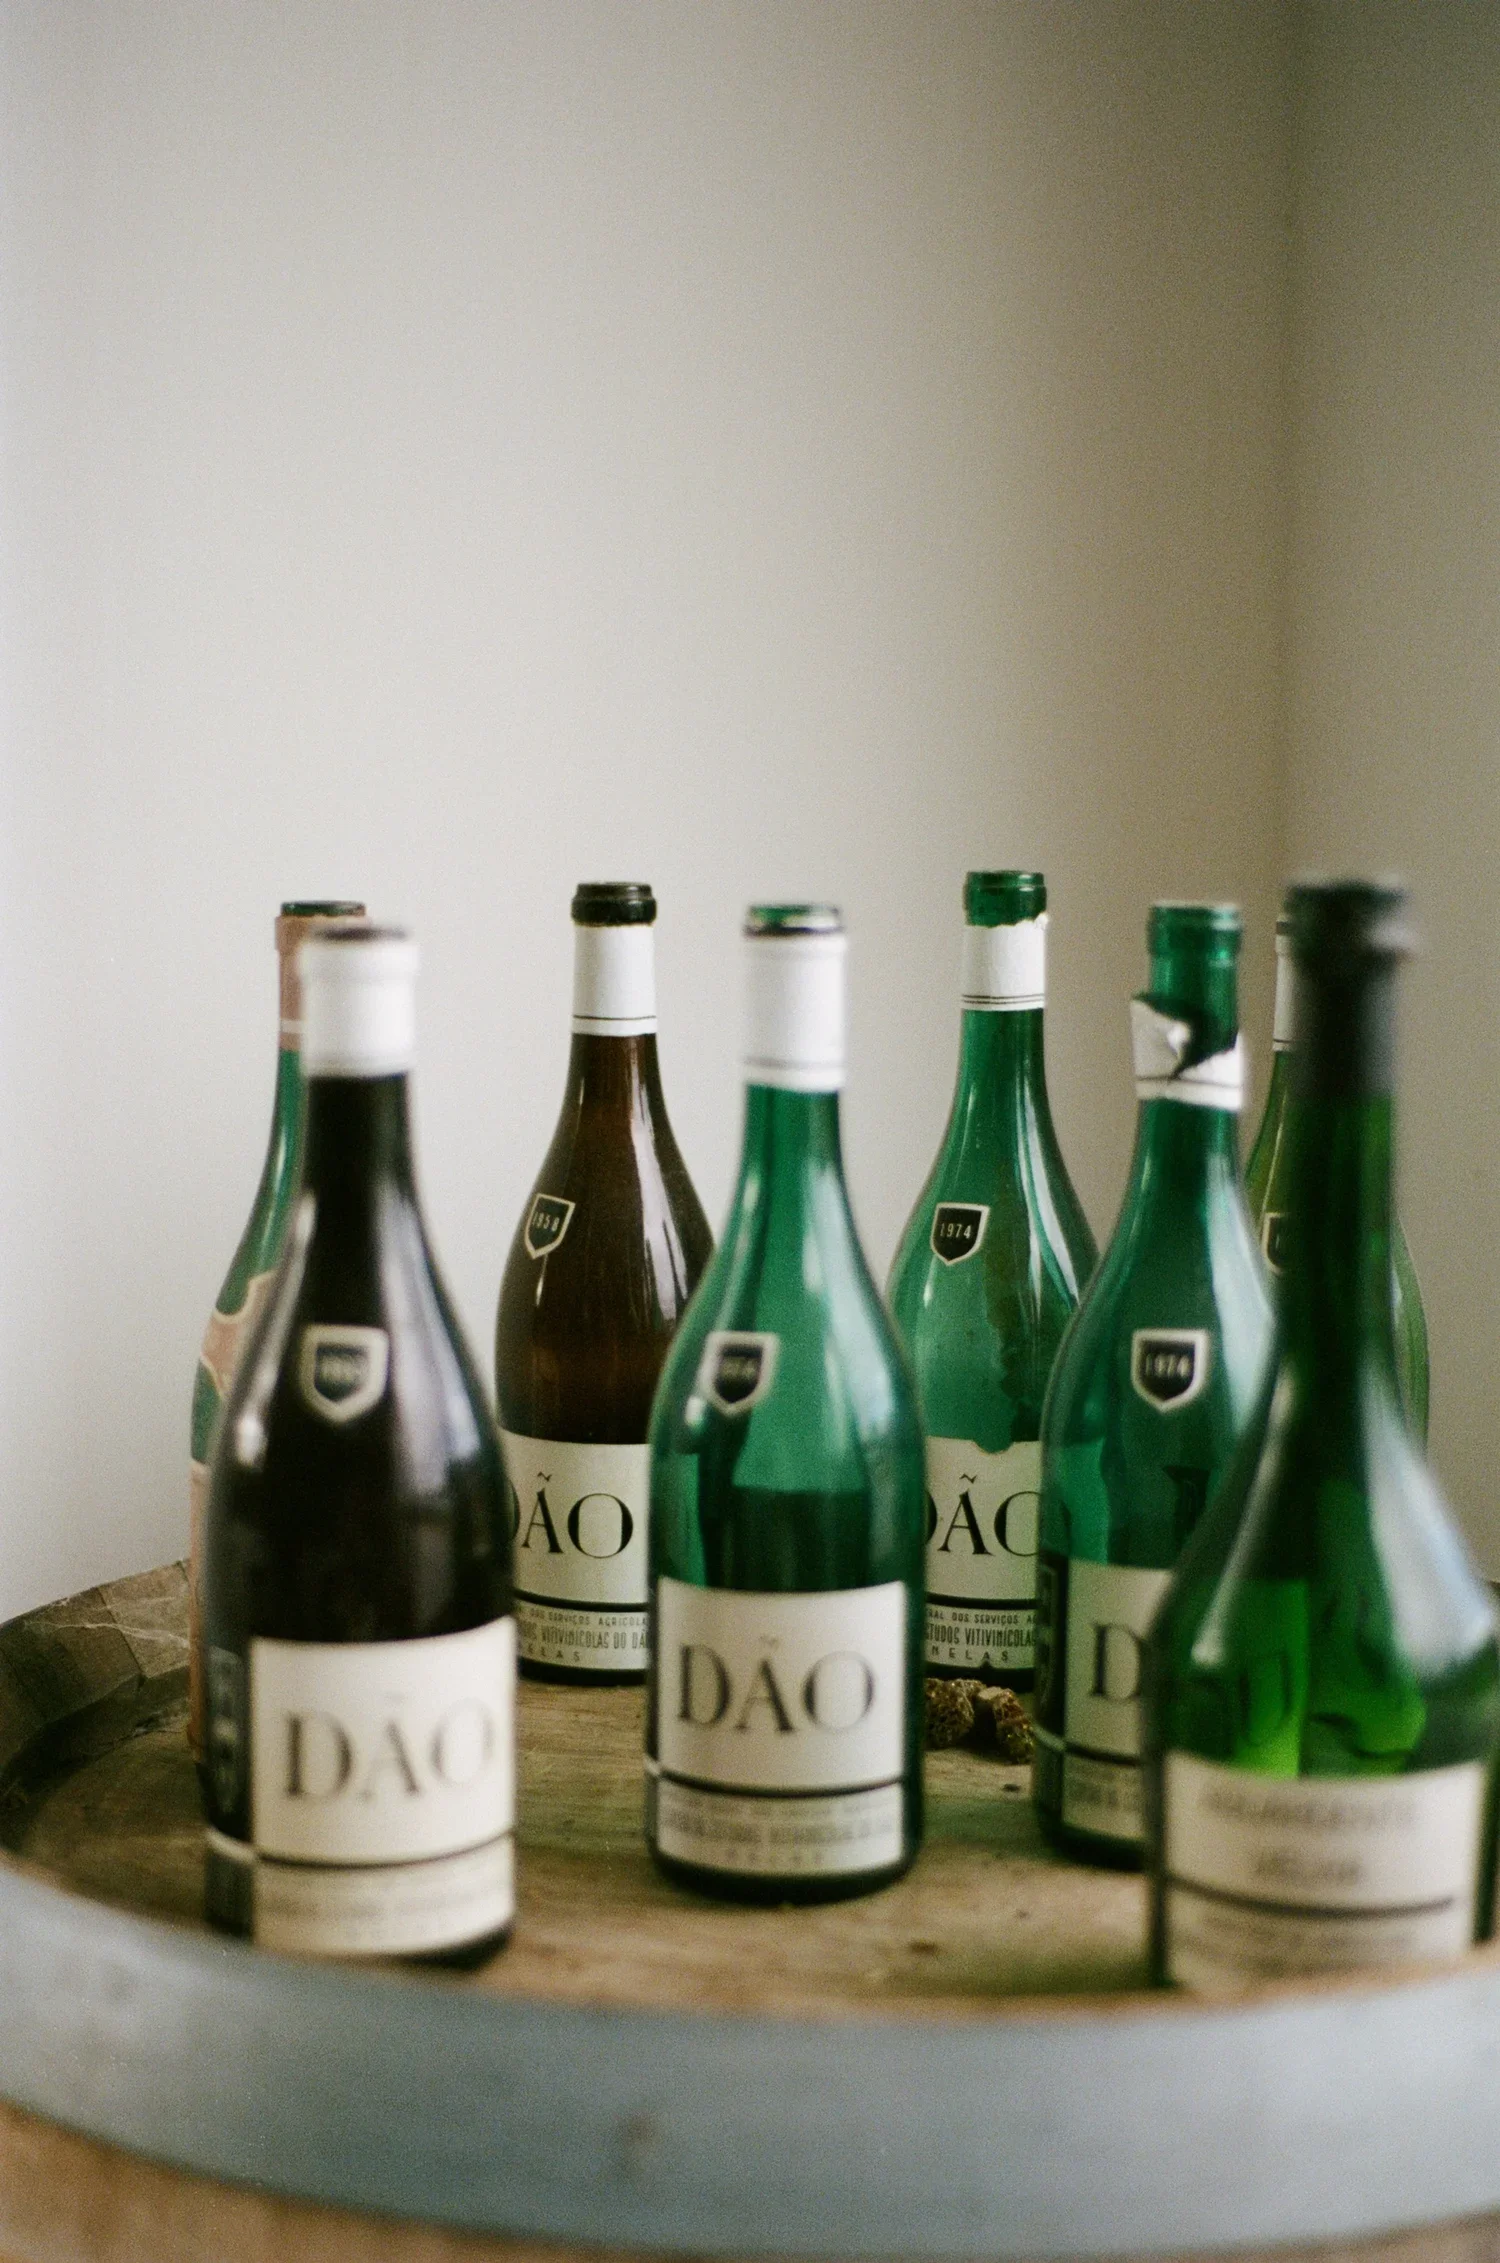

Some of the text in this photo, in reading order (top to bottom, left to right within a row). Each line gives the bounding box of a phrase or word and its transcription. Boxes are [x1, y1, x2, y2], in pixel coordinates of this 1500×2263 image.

[940, 1222, 972, 1239] 1974
[951, 1611, 969, 1622] DOS
[974, 1613, 1019, 1626] SERVIÇOS
[632, 1628, 648, 1650] DÃ
[676, 1632, 877, 1733] DÃO
